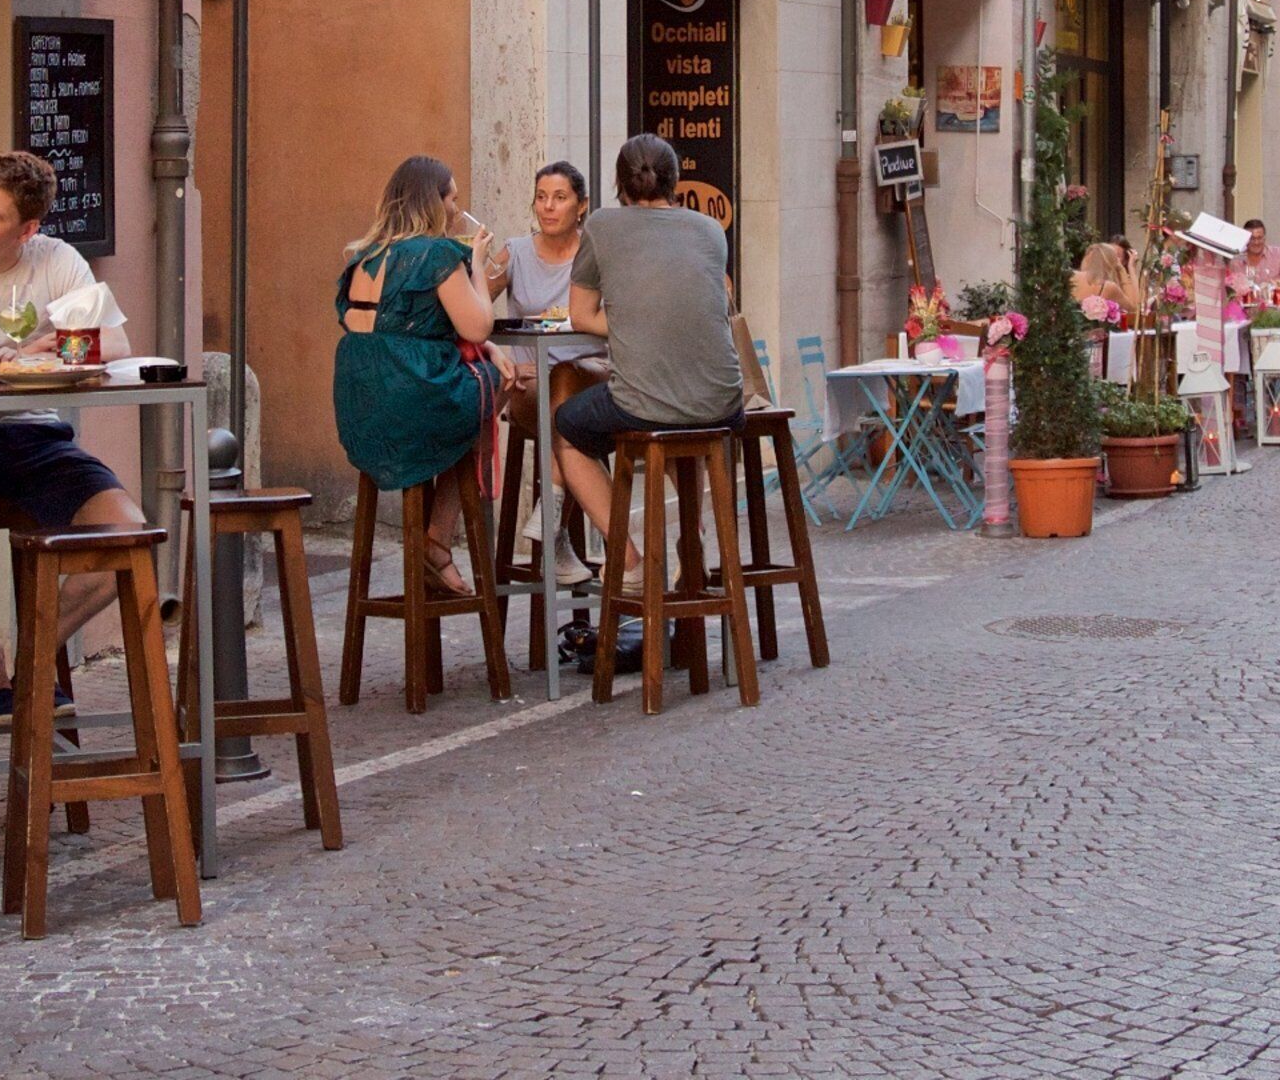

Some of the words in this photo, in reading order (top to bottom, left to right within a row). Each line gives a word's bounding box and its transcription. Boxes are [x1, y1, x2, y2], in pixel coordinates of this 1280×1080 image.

[650, 22, 727, 43] Occhiali
[666, 54, 712, 75] vista
[648, 85, 730, 112] completi
[656, 118, 674, 139] di
[680, 118, 721, 139] lenti
[681, 156, 697, 171] da
